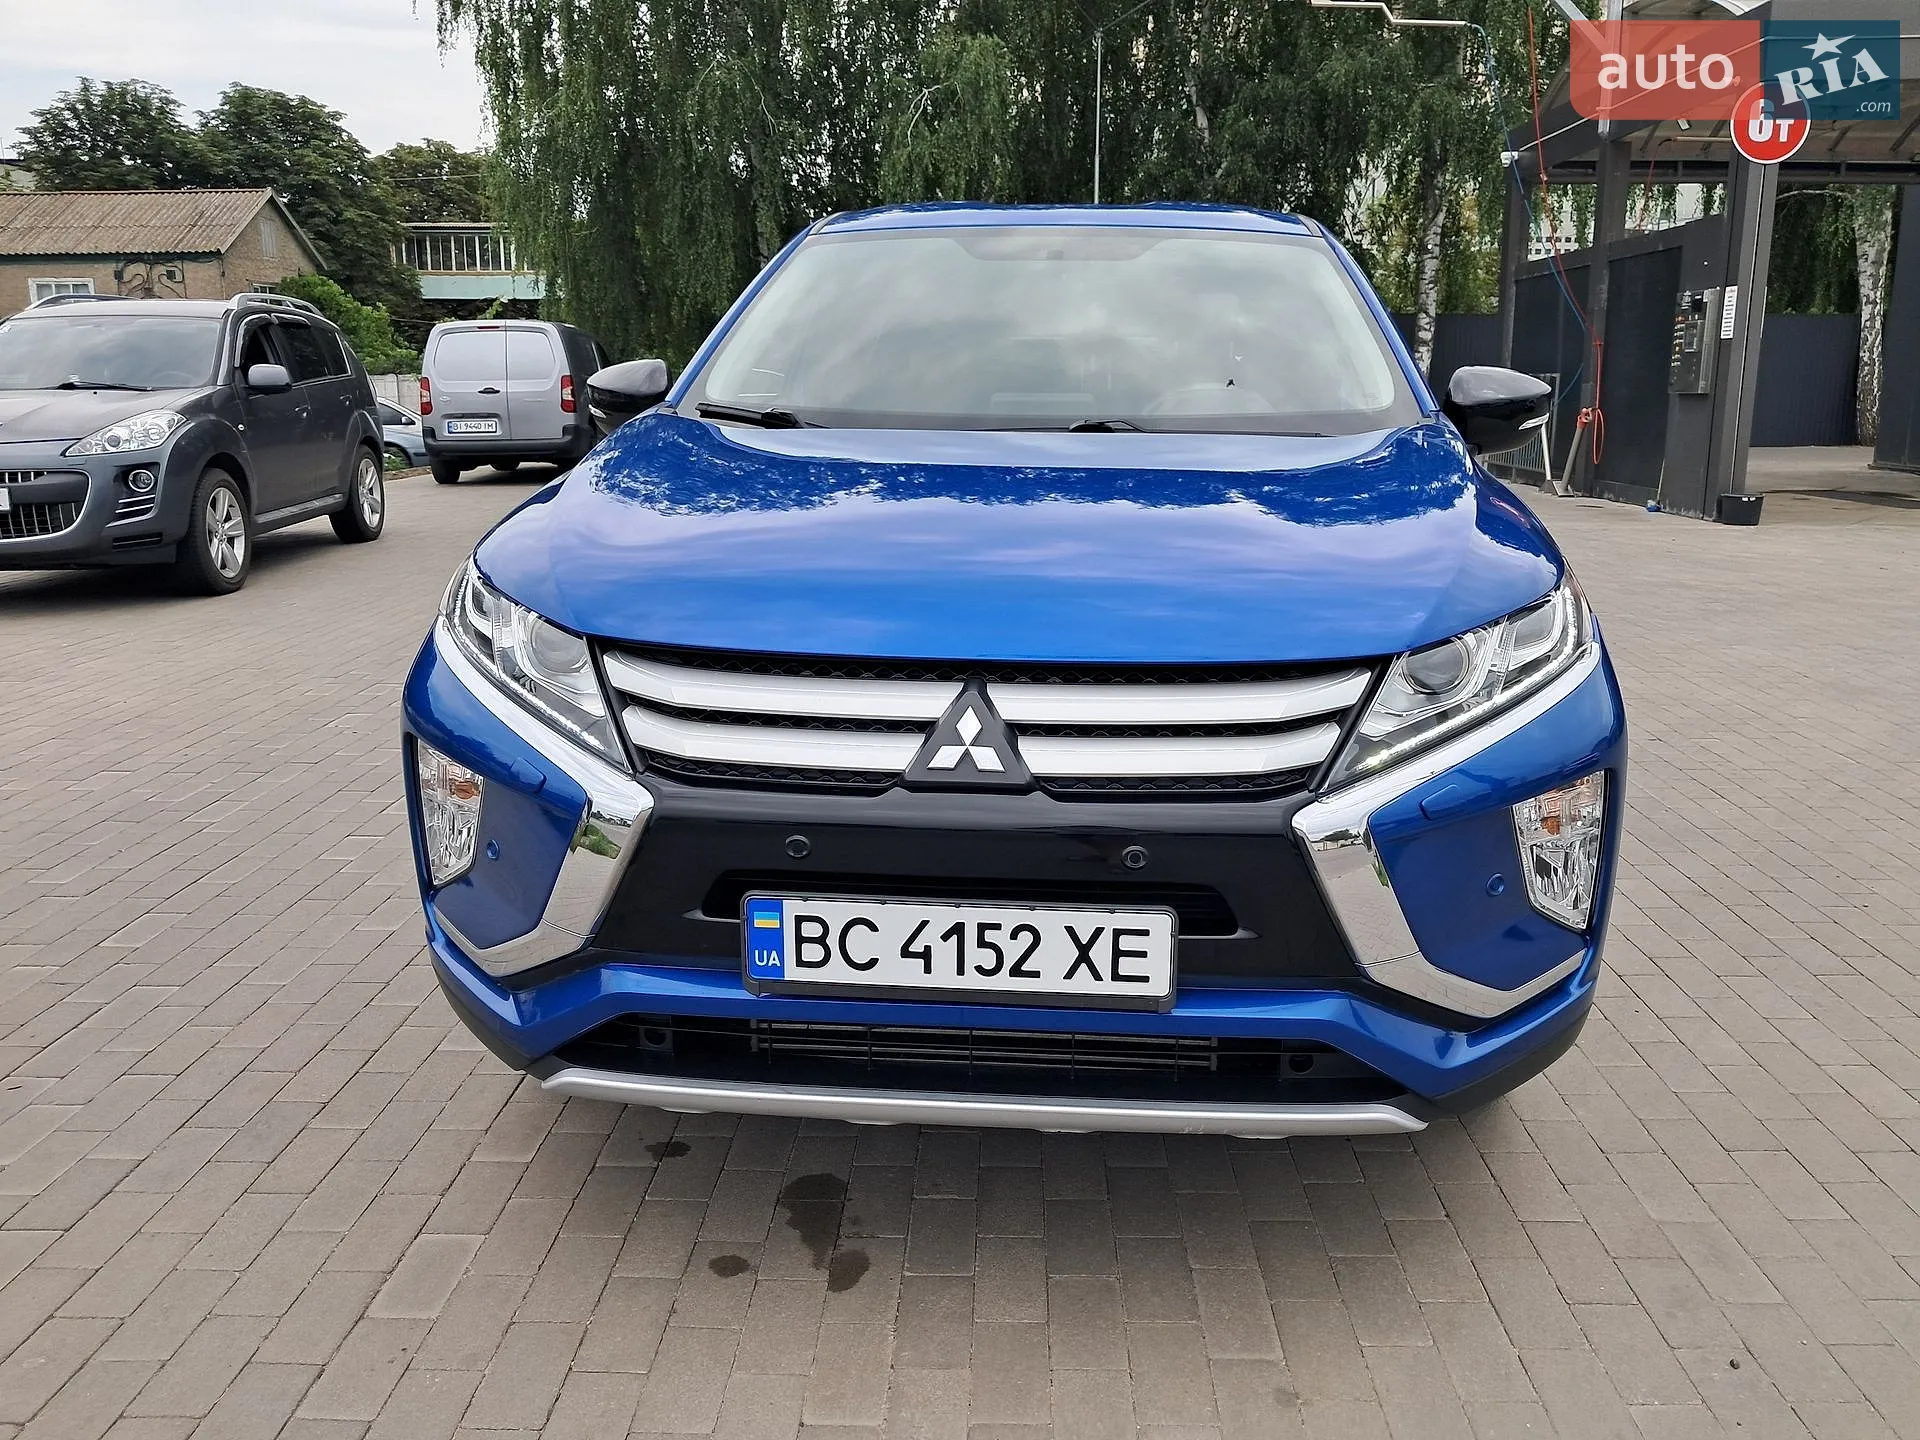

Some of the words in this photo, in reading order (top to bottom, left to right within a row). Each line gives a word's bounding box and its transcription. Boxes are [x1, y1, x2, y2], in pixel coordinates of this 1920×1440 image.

[754, 949, 781, 967] UA
[794, 914, 880, 972] BC
[900, 919, 1042, 979] 4152
[1062, 925, 1151, 983] XE
